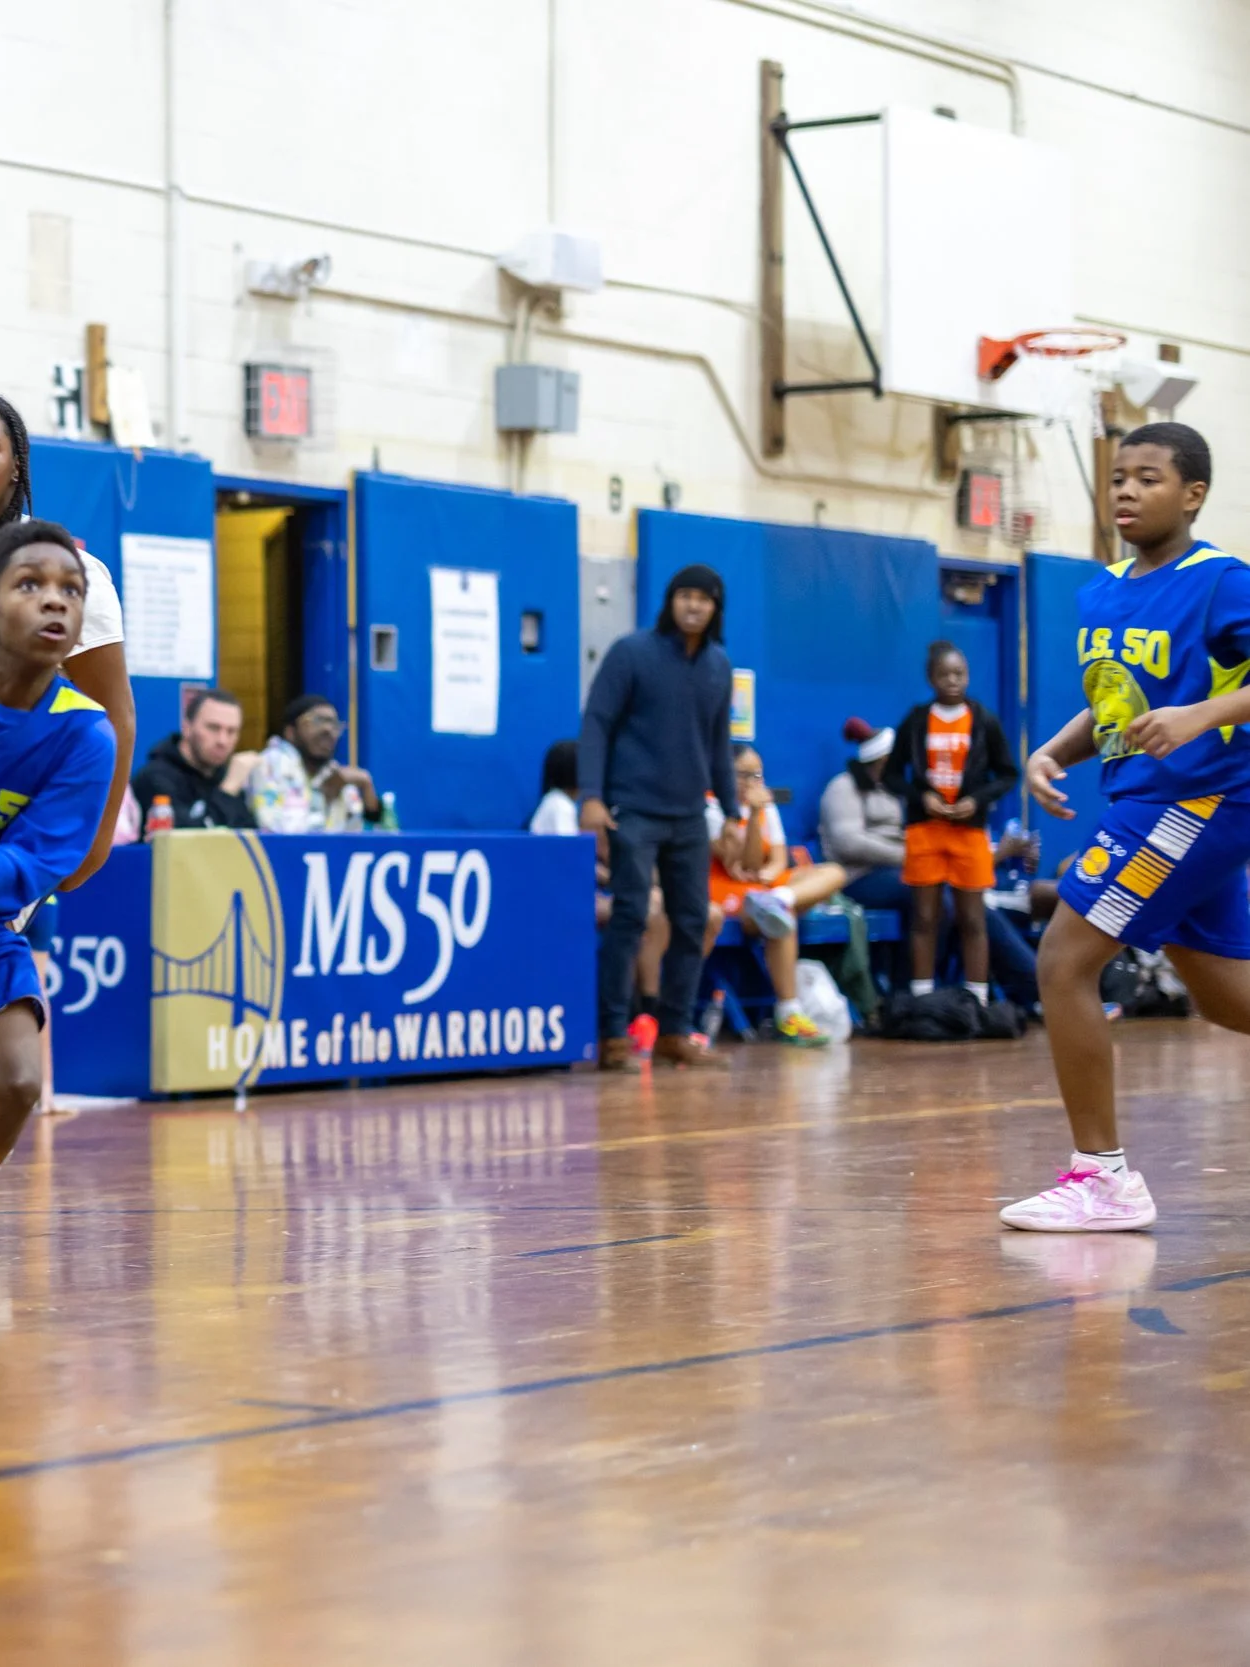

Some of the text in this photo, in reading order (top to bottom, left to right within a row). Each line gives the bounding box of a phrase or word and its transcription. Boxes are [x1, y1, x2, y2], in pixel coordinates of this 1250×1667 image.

[1120, 627, 1172, 680] 50
[207, 1004, 565, 1071] HOME of the WARRIORS
